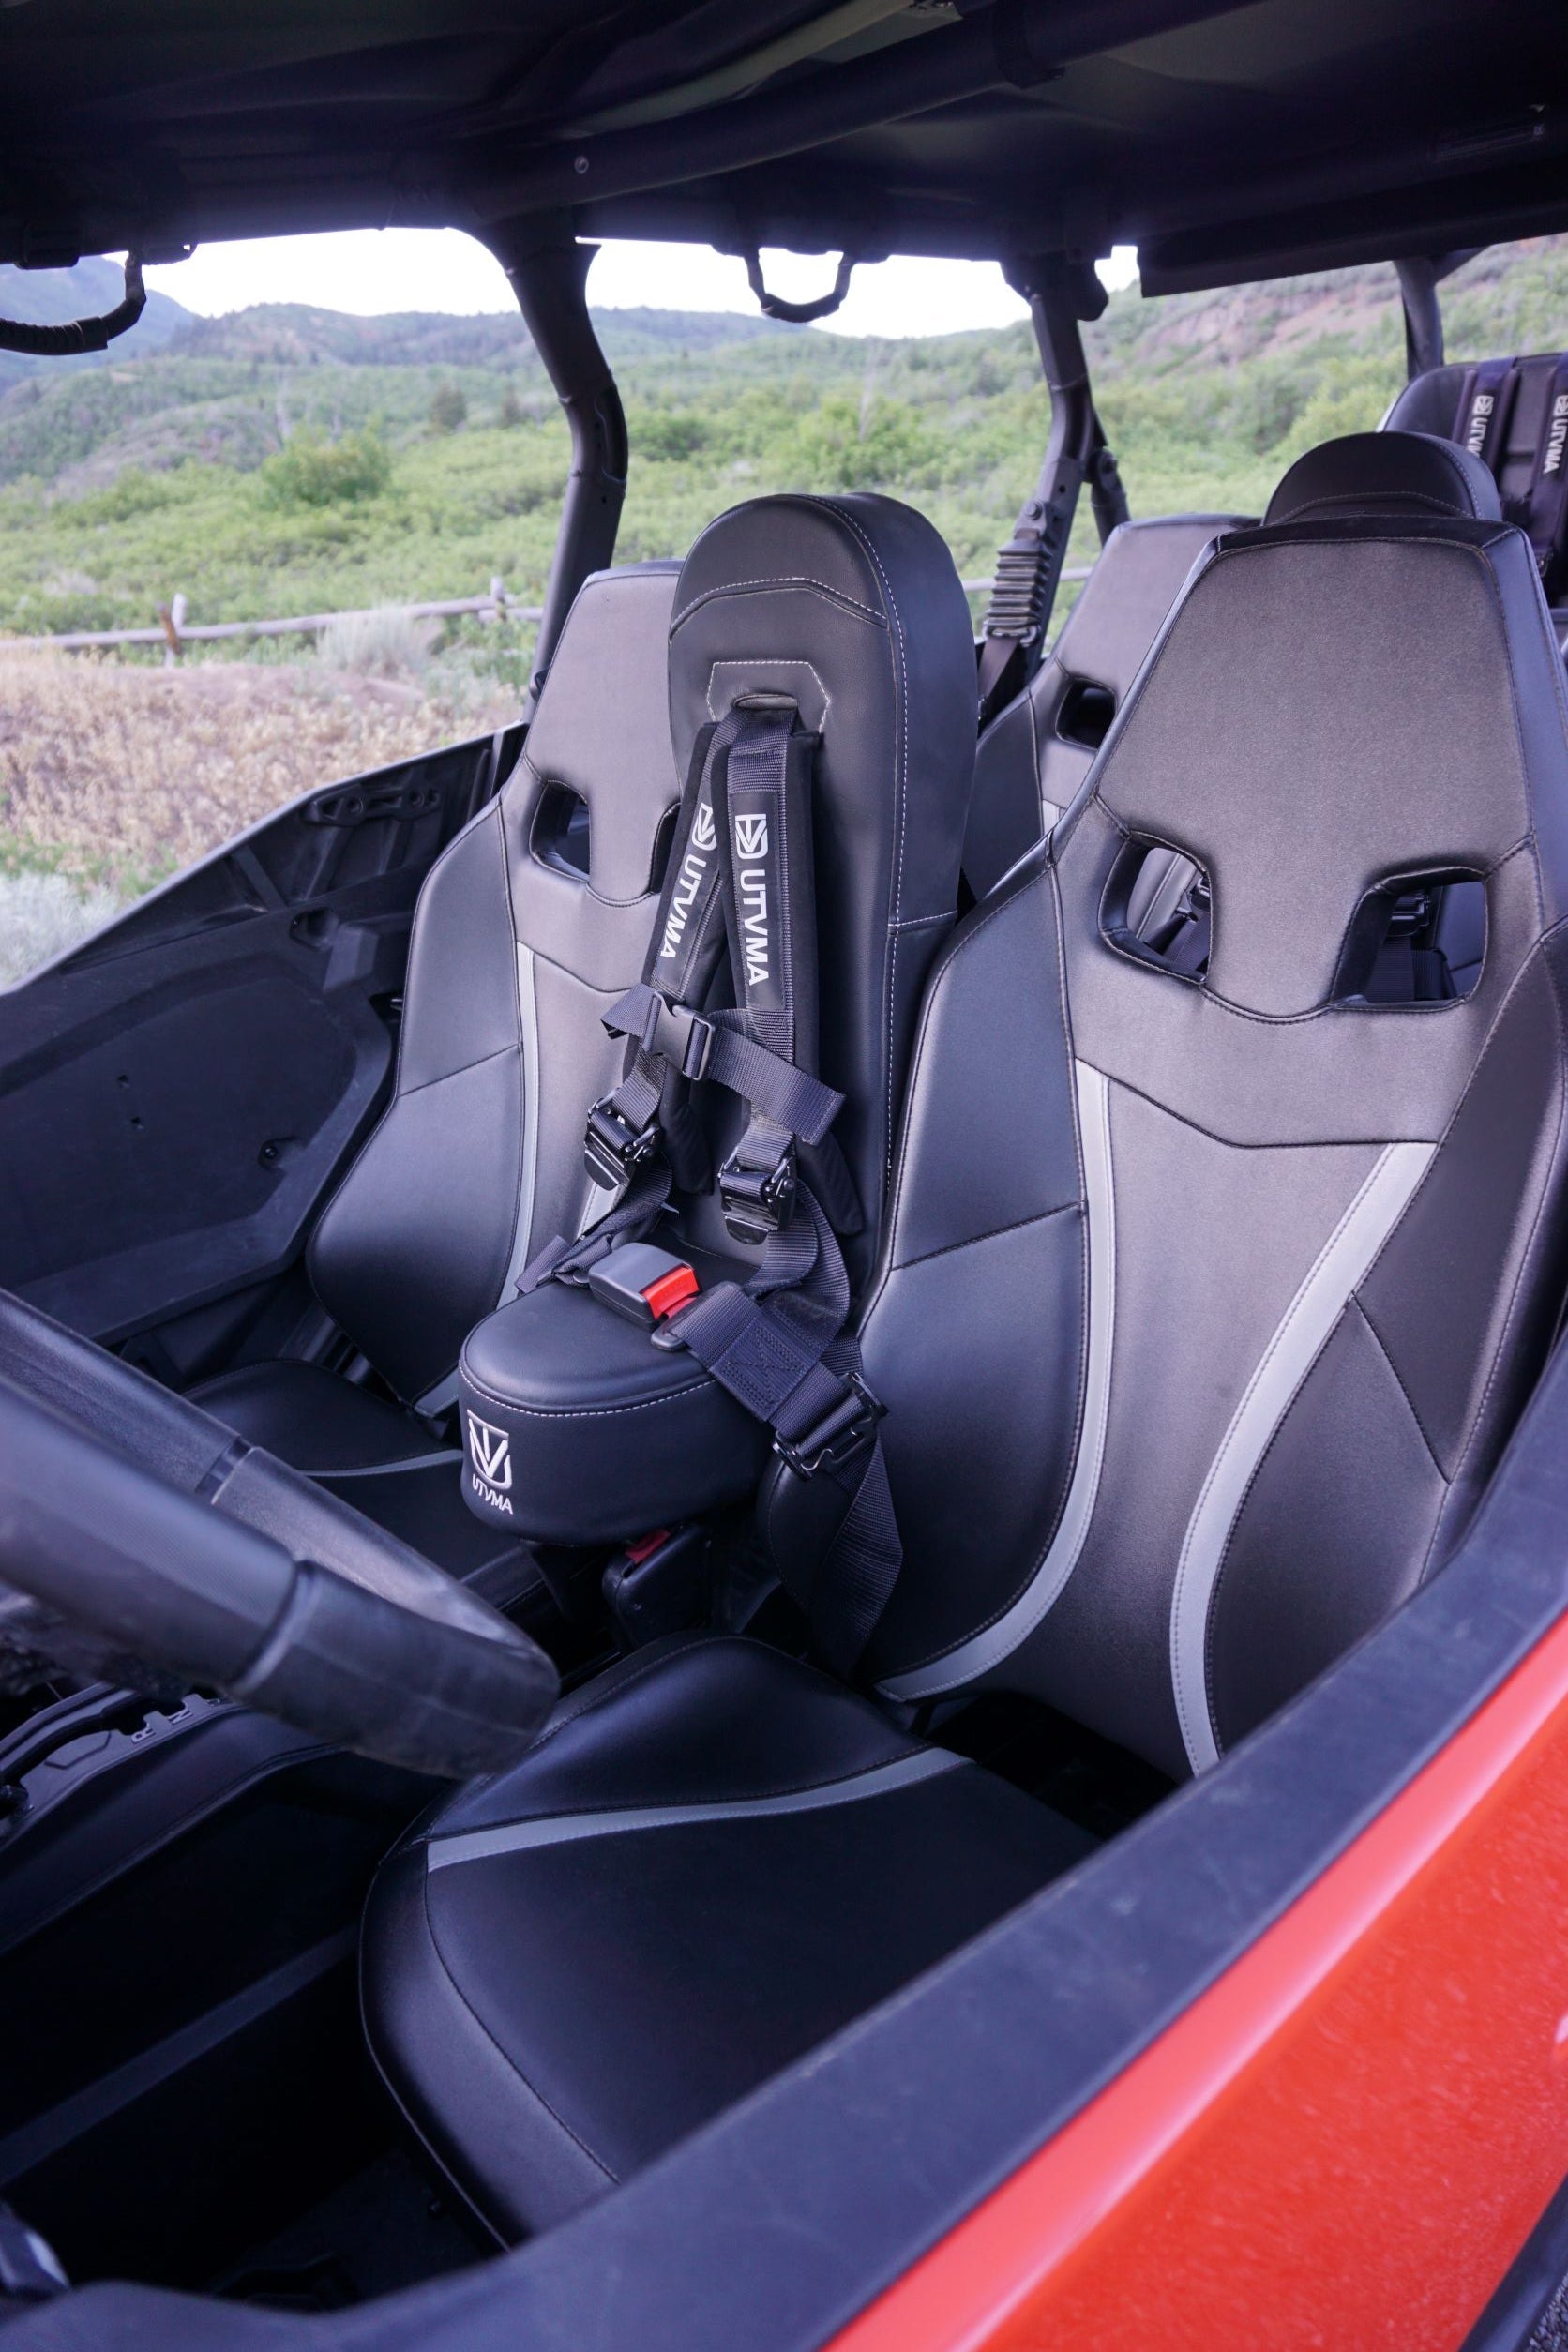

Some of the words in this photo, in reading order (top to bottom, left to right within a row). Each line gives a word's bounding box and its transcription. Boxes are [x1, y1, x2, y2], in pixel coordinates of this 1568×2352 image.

[1543, 418, 1568, 473] UTVMA
[660, 854, 706, 958] UTVMA
[740, 869, 770, 987] UTVMA
[472, 1473, 514, 1515] UTVMA
